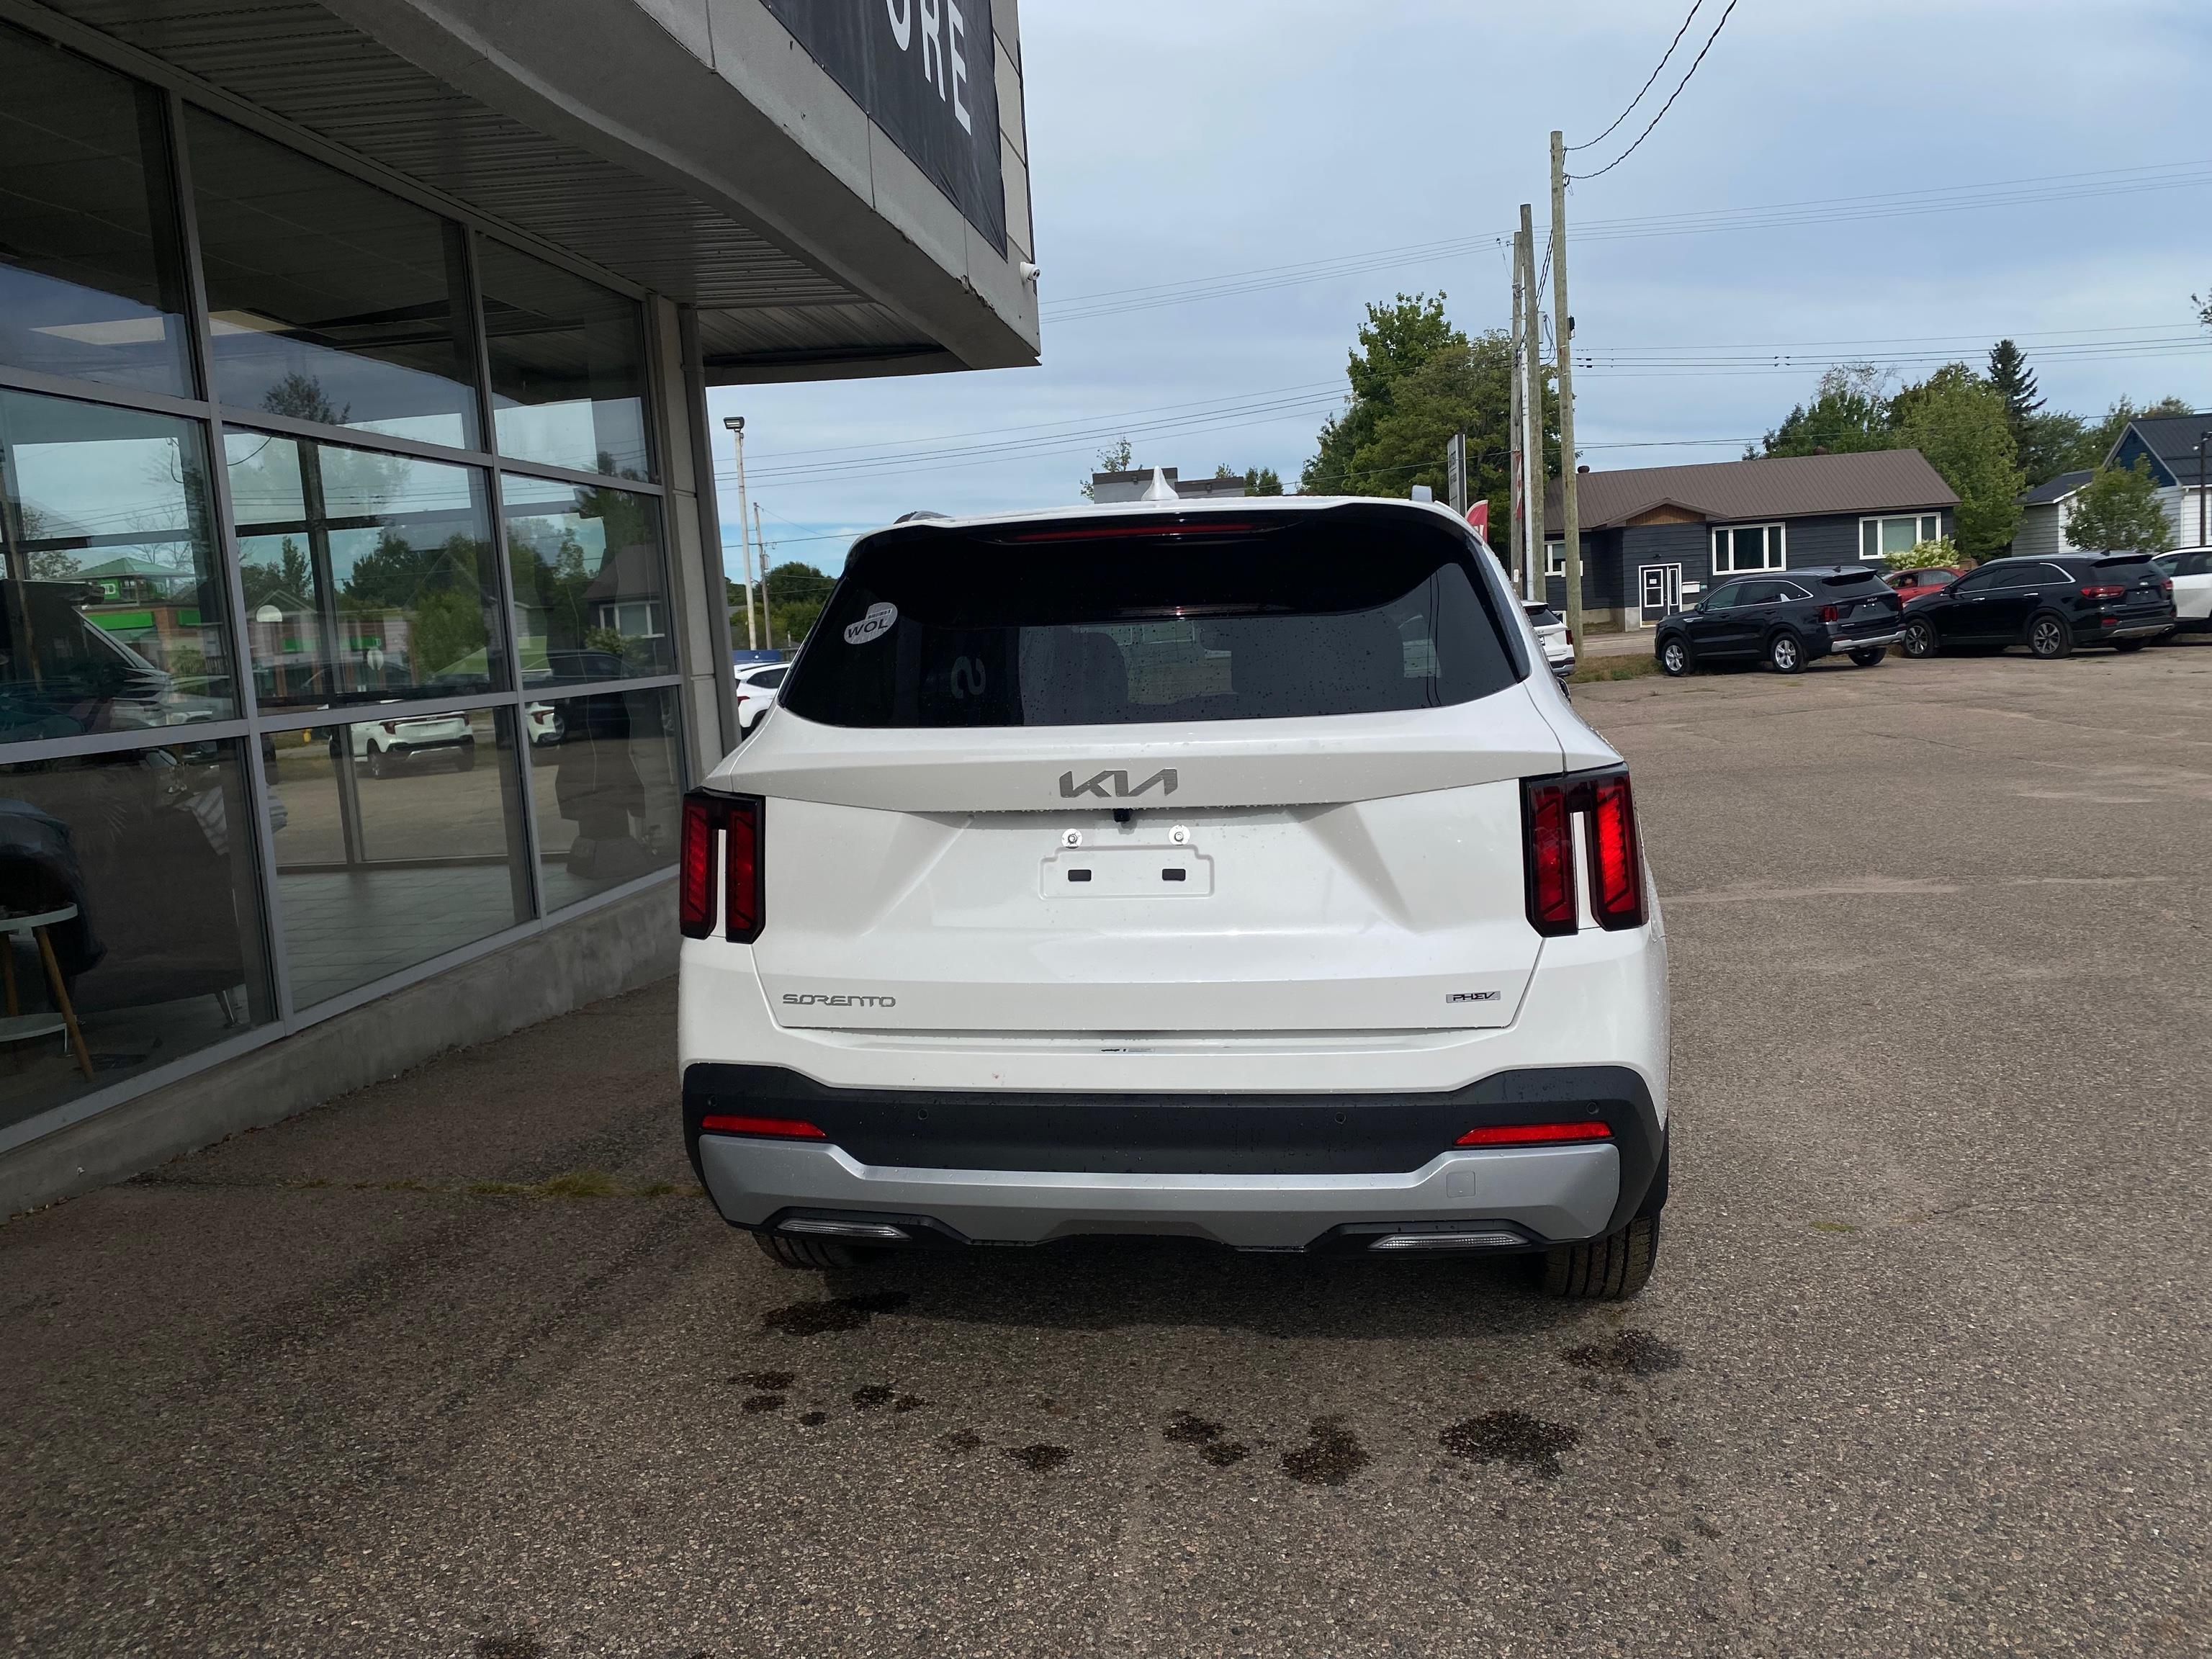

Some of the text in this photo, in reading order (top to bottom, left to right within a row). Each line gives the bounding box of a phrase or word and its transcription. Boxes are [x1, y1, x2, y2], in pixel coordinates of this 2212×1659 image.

[848, 619, 889, 638] WOL
[1059, 768, 1178, 799] KIA
[783, 994, 896, 1007] SORENTO
[1453, 992, 1496, 1002] PHEV
